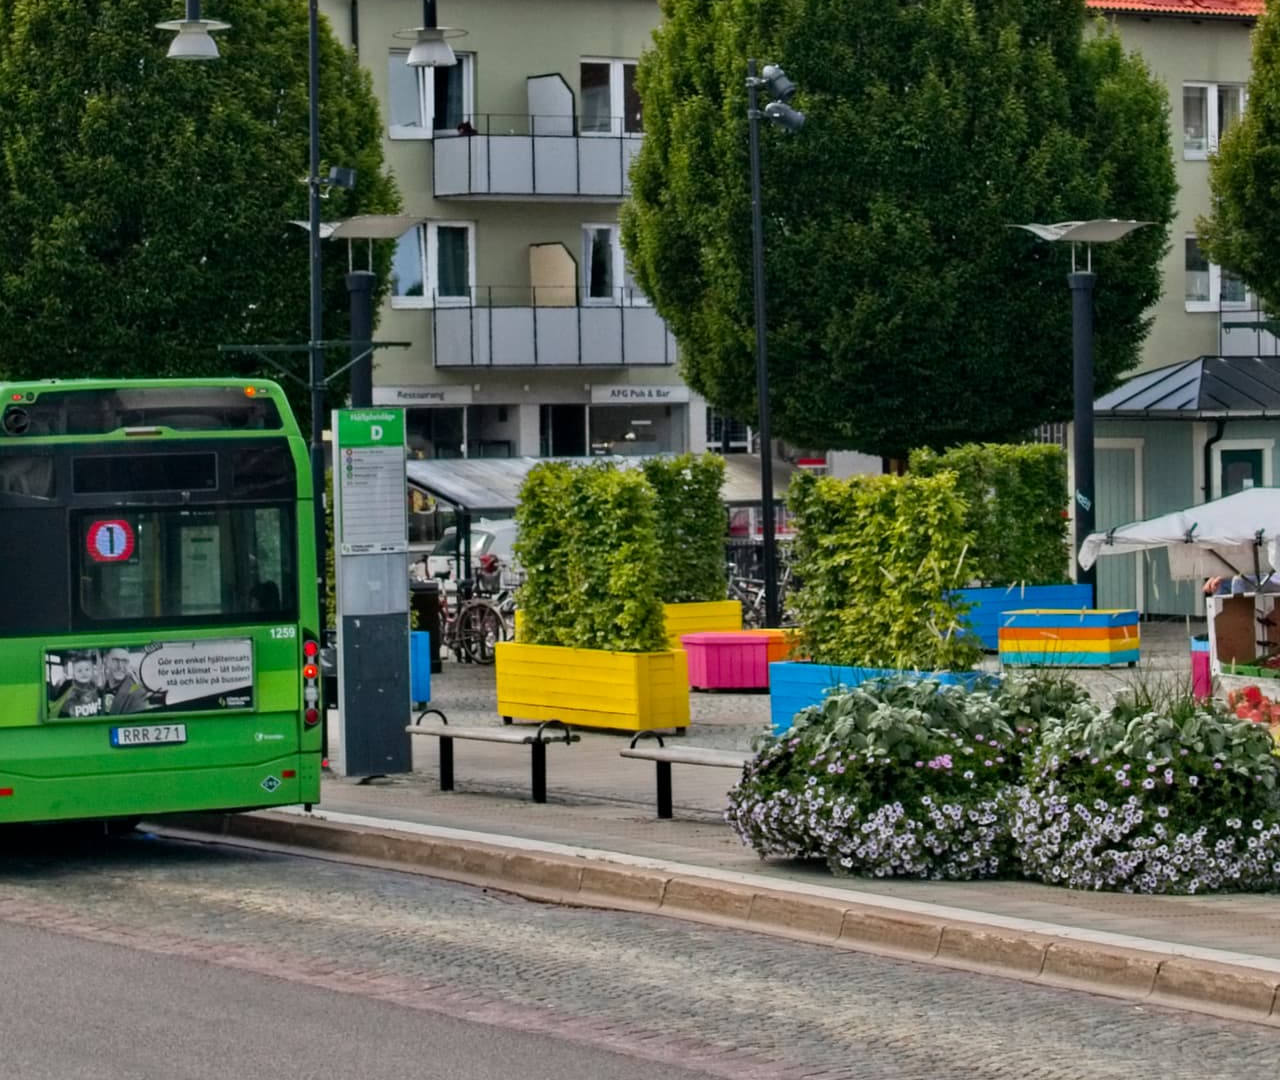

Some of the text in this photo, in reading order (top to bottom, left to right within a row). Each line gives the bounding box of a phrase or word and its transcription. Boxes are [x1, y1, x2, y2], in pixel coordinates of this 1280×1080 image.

[656, 389, 670, 398] Bar
[371, 425, 383, 440] D
[106, 526, 115, 555] 1
[270, 627, 296, 639] 1259
[185, 655, 206, 665] enkel
[187, 665, 211, 675] klimat
[179, 676, 194, 686] och
[210, 675, 221, 686] på
[74, 697, 102, 718] POW!
[123, 726, 181, 742] RRR 271
